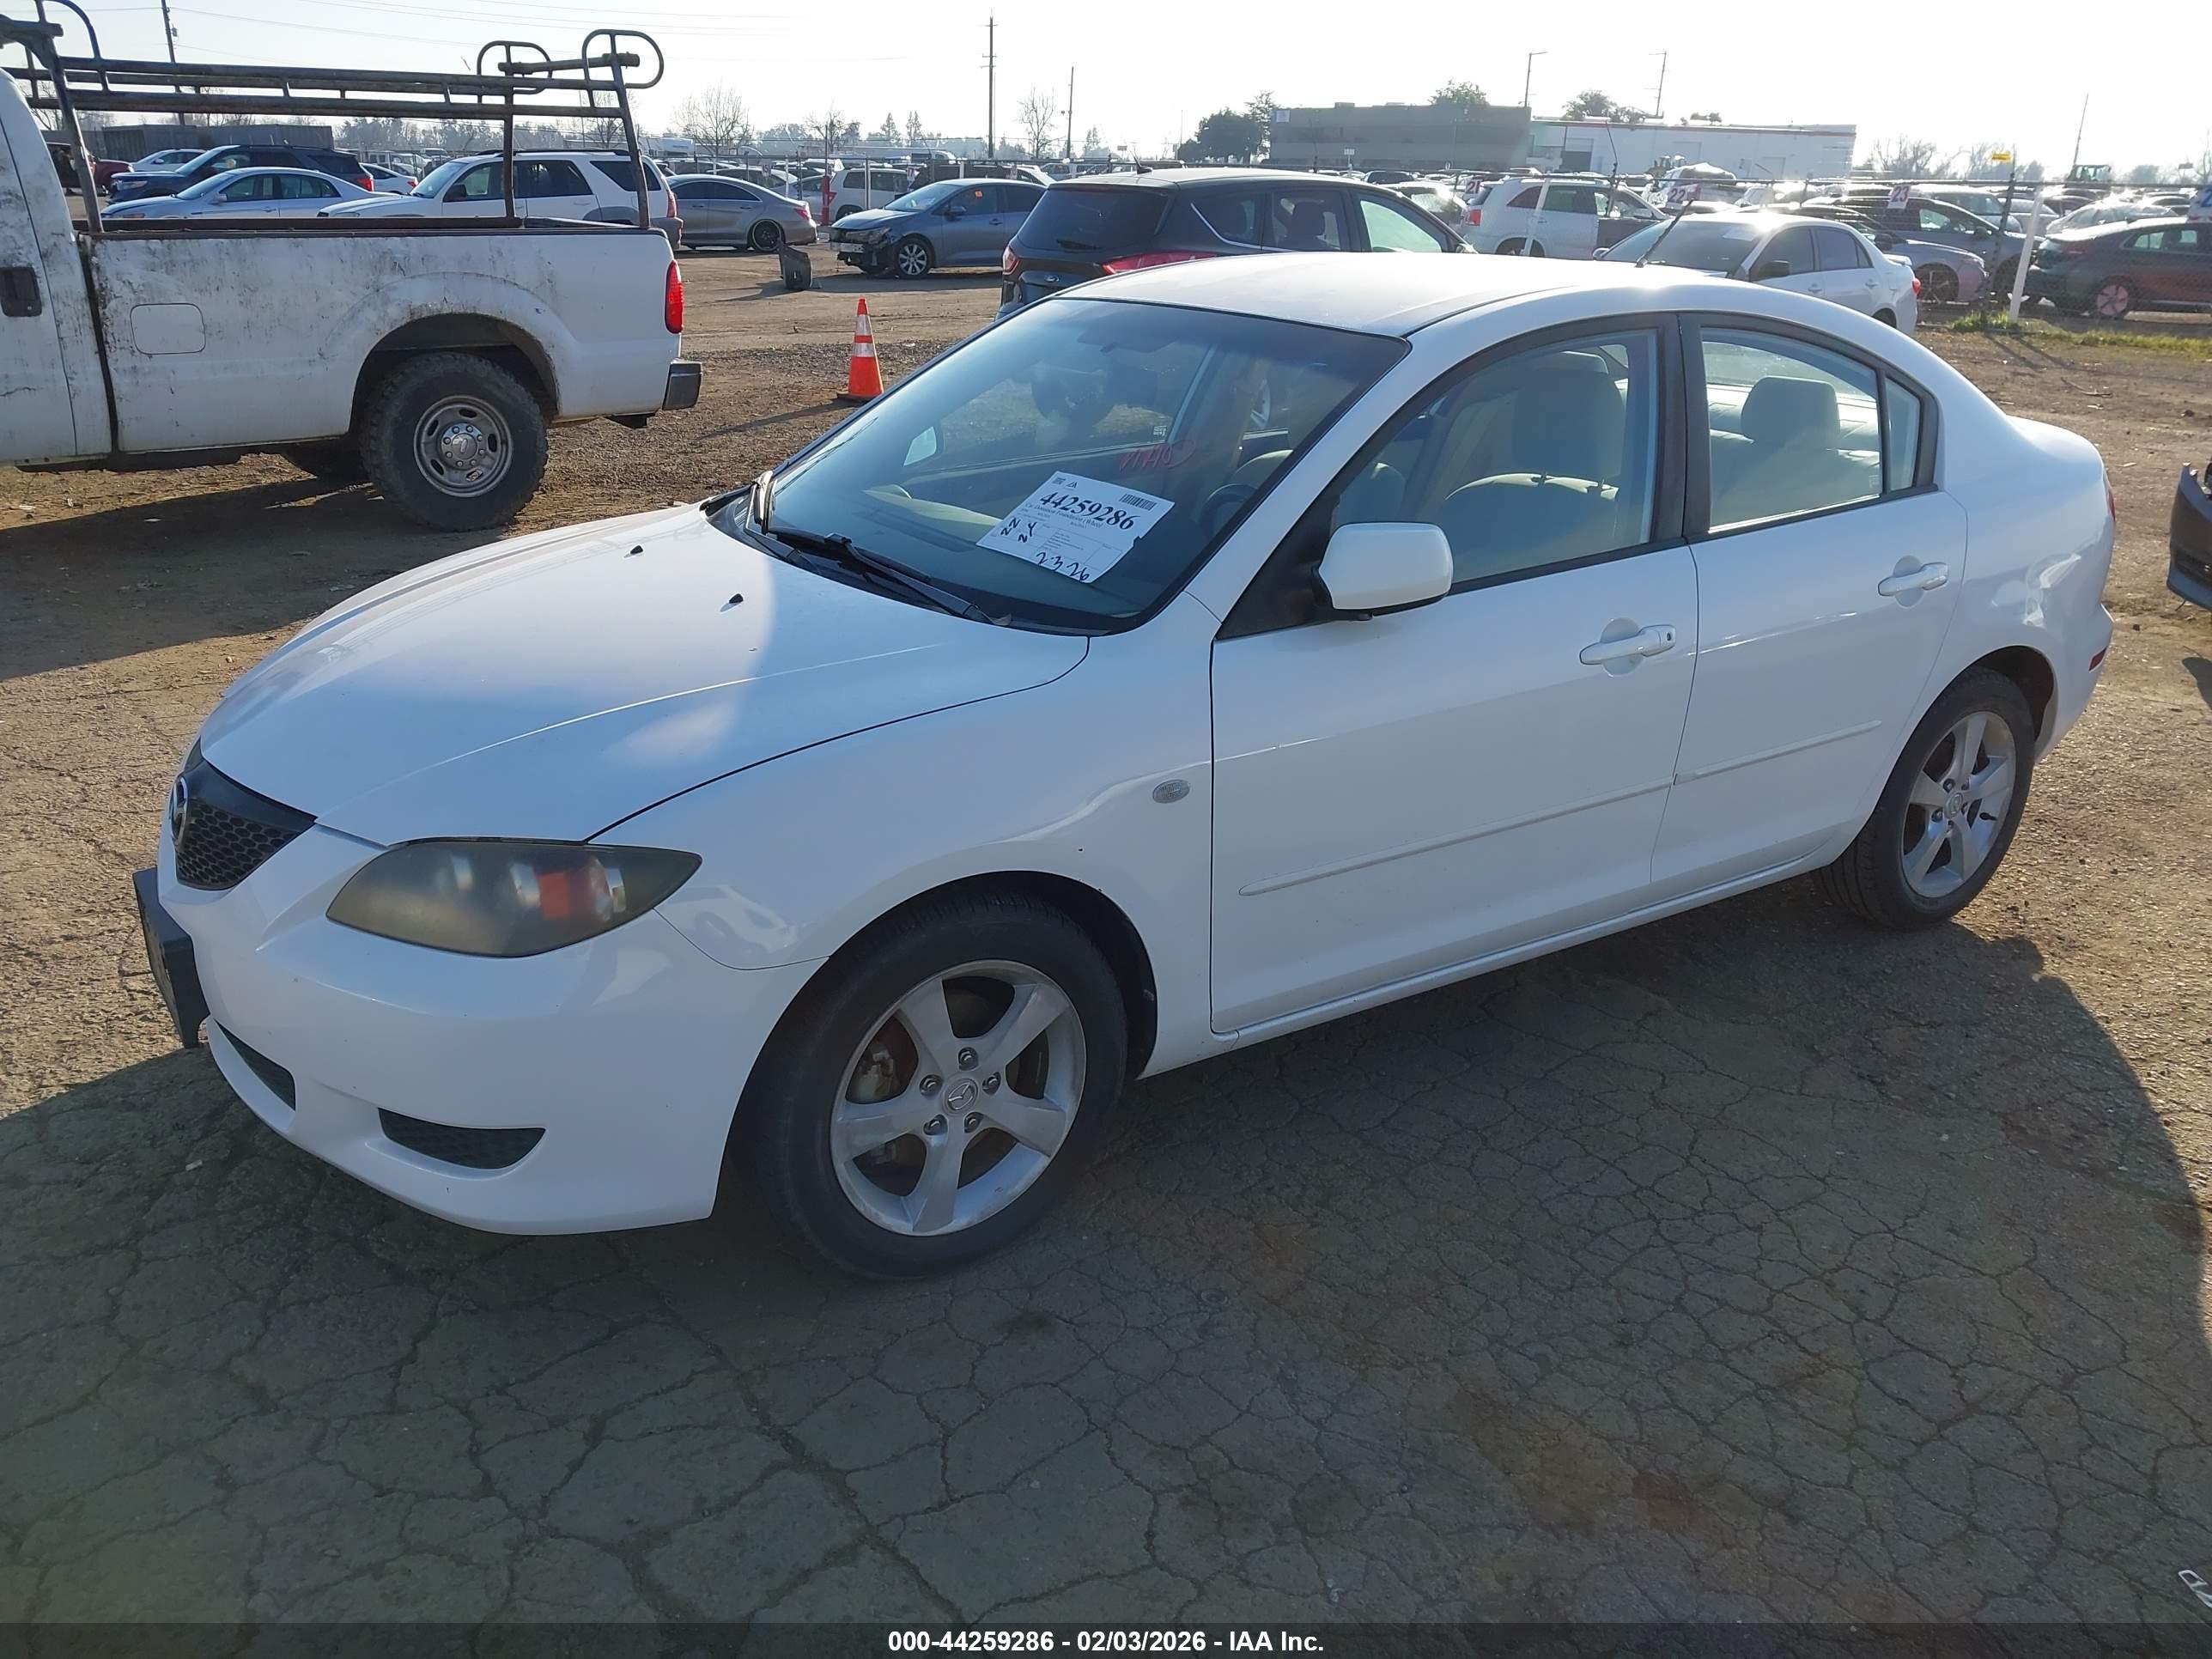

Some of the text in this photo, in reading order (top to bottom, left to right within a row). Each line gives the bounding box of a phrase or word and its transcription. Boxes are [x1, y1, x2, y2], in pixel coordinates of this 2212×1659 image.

[1668, 188, 1686, 204] 22
[1891, 185, 1910, 203] 23
[1039, 491, 1140, 530] 44259286
[1027, 521, 1038, 538] Y
